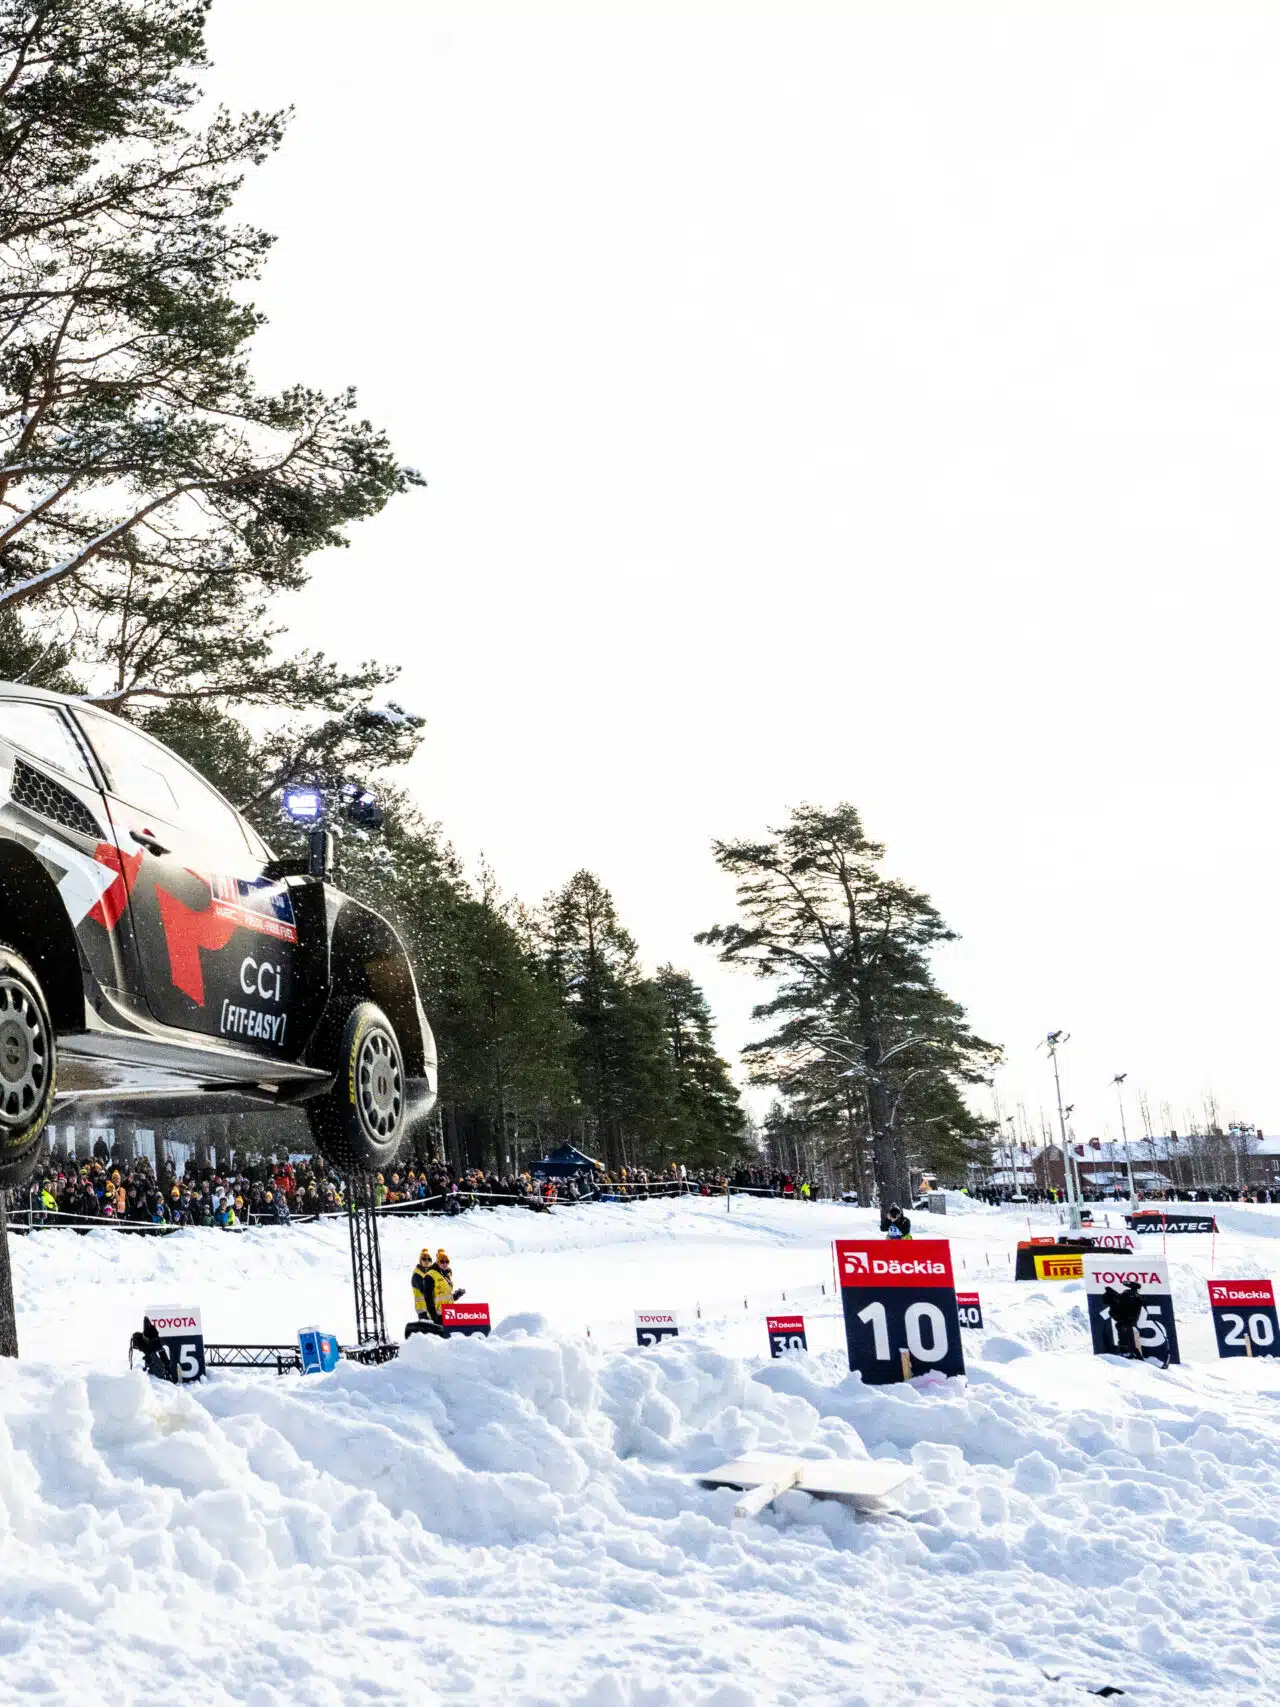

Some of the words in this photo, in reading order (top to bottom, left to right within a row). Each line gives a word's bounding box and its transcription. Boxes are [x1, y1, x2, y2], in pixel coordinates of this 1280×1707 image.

[1136, 1222, 1209, 1233] FANATEC
[1096, 1235, 1135, 1249] YOTA
[872, 1260, 946, 1275] Däckia
[1043, 1260, 1082, 1277] PIRE
[1092, 1272, 1162, 1285] TOYOTA
[1228, 1291, 1271, 1299] Däckia
[151, 1317, 196, 1328] TOYOTA
[456, 1312, 488, 1320] Däckia
[639, 1315, 673, 1323] TOYOTA
[958, 1308, 979, 1324] 40
[857, 1302, 949, 1363] 10
[1220, 1313, 1274, 1346] 20
[773, 1336, 804, 1357] 30
